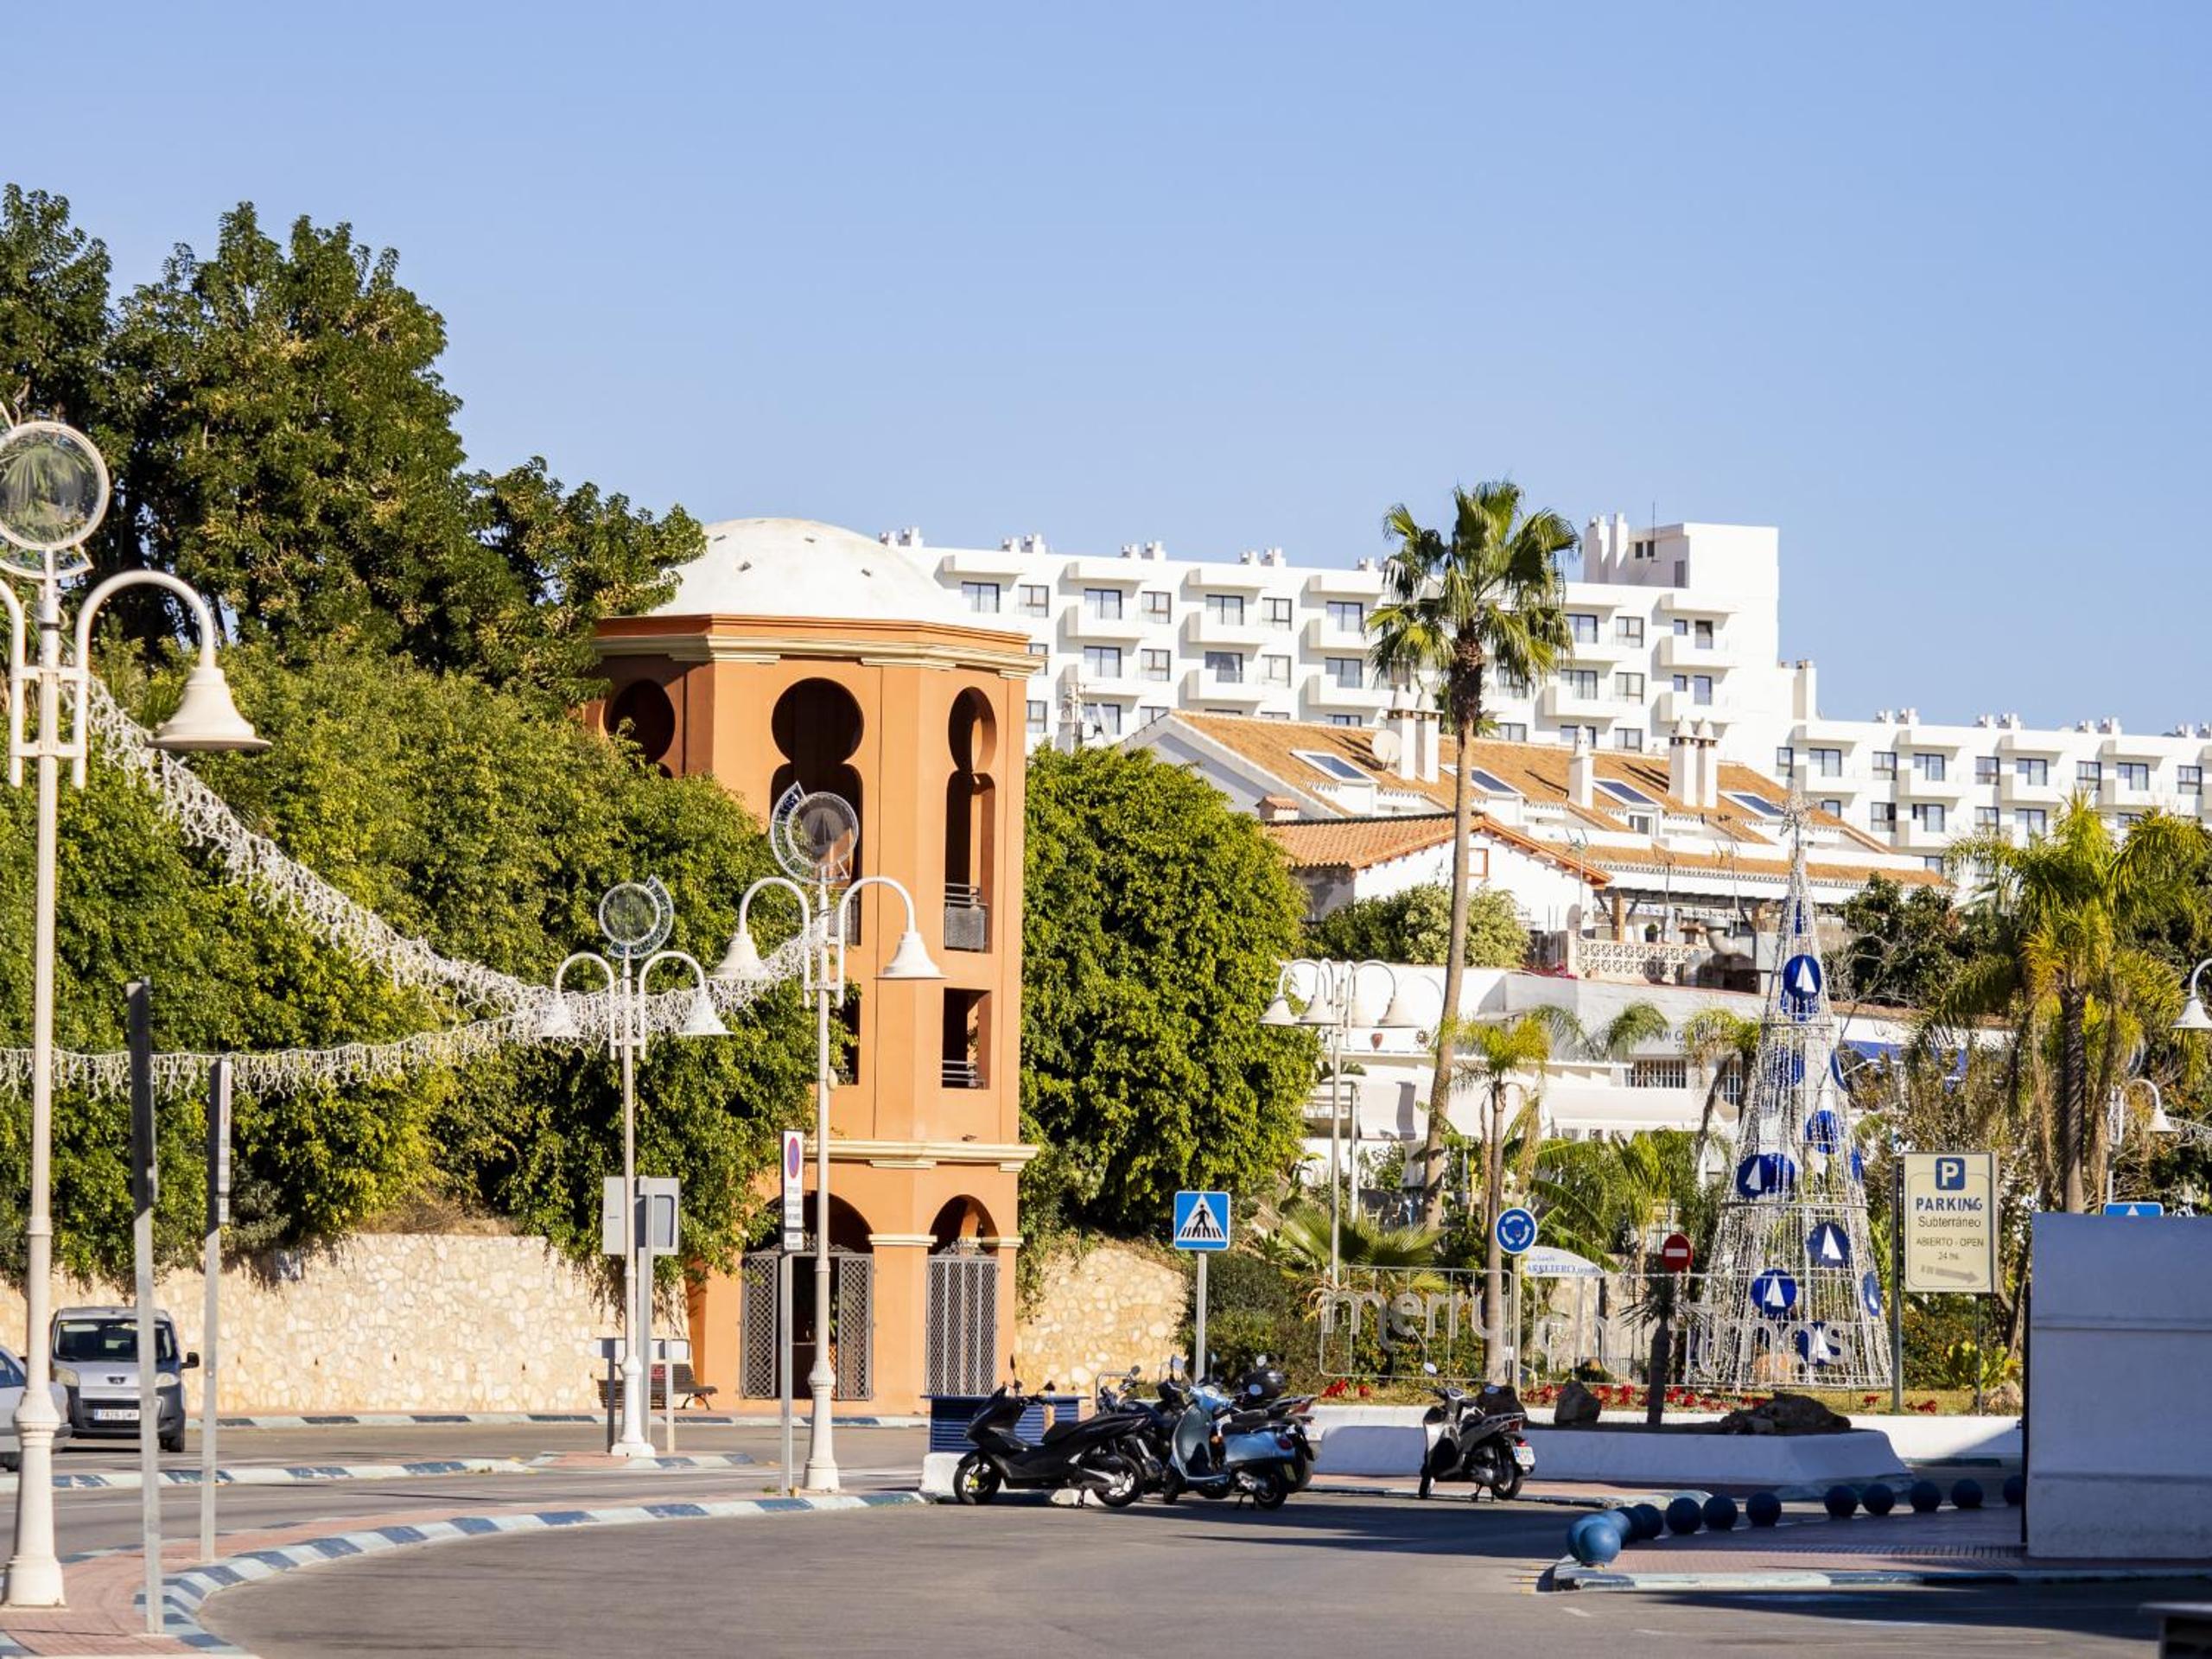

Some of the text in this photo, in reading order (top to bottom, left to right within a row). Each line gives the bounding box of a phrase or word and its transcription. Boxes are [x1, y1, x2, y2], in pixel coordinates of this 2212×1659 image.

[1942, 1161, 1959, 1186] P
[1916, 1197, 1983, 1211] PARKING
[1918, 1216, 1982, 1228] Subterráneo
[1916, 1237, 1953, 1247] ABIERTO
[1960, 1238, 1985, 1247] OPEN
